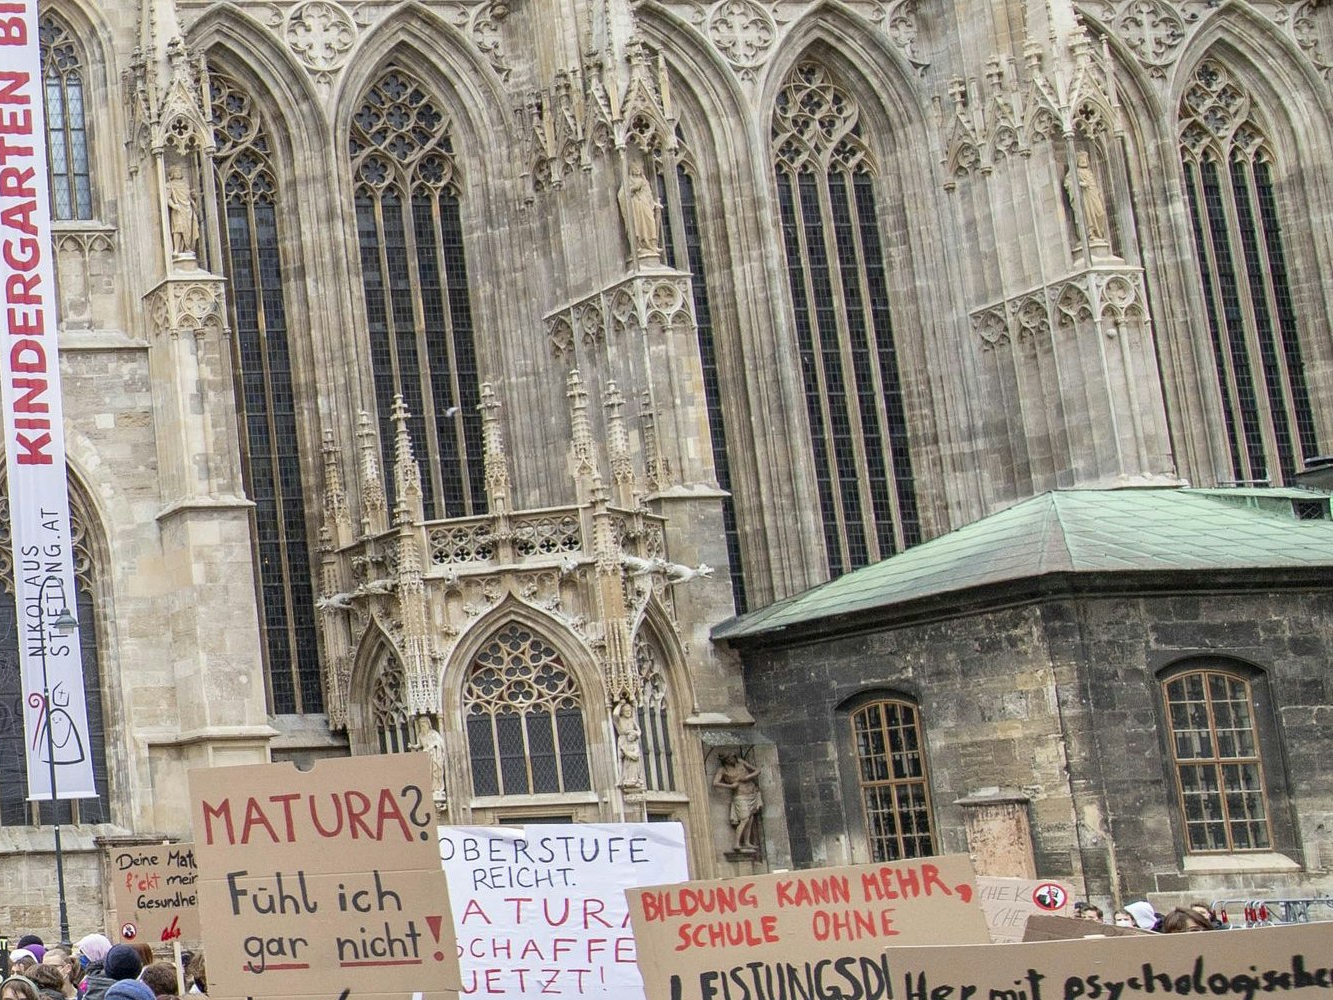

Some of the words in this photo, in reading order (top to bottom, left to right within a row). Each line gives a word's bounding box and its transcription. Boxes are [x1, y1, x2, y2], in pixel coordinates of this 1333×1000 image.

[22, 545, 47, 656] NIKOLAUS
[202, 785, 431, 845] MATURA?
[115, 853, 159, 870] Deine
[439, 837, 650, 863] OBERSTUFE
[227, 870, 318, 915] Fühl
[338, 870, 402, 913] ich
[473, 866, 577, 891] REICHT.
[641, 882, 759, 922] BILDUNG
[776, 874, 850, 907] KANN
[861, 863, 972, 903] MEHR,
[462, 898, 631, 929] ATUR
[675, 914, 779, 951] SCHULE
[812, 908, 900, 942] OHNE
[244, 935, 309, 973] gar
[462, 966, 607, 995] JETZT!
